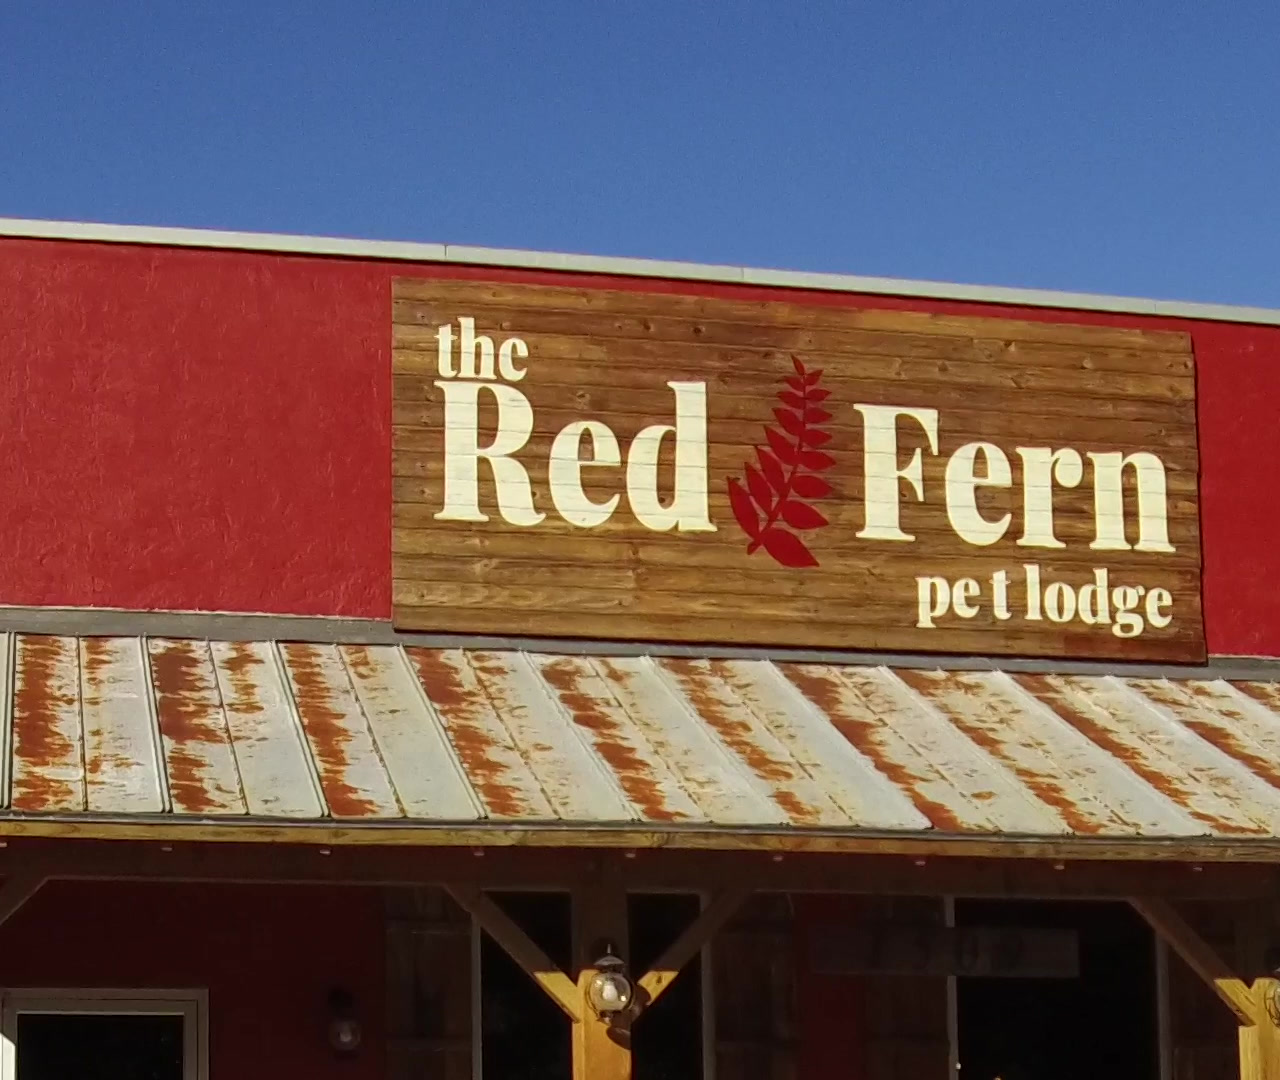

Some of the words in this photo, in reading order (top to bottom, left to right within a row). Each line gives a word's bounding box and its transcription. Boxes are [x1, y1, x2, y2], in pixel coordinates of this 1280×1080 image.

[434, 317, 529, 382] the
[433, 380, 718, 532] Red
[853, 403, 1176, 552] Fern
[915, 569, 1012, 628] pet
[1023, 563, 1173, 638] lodge
